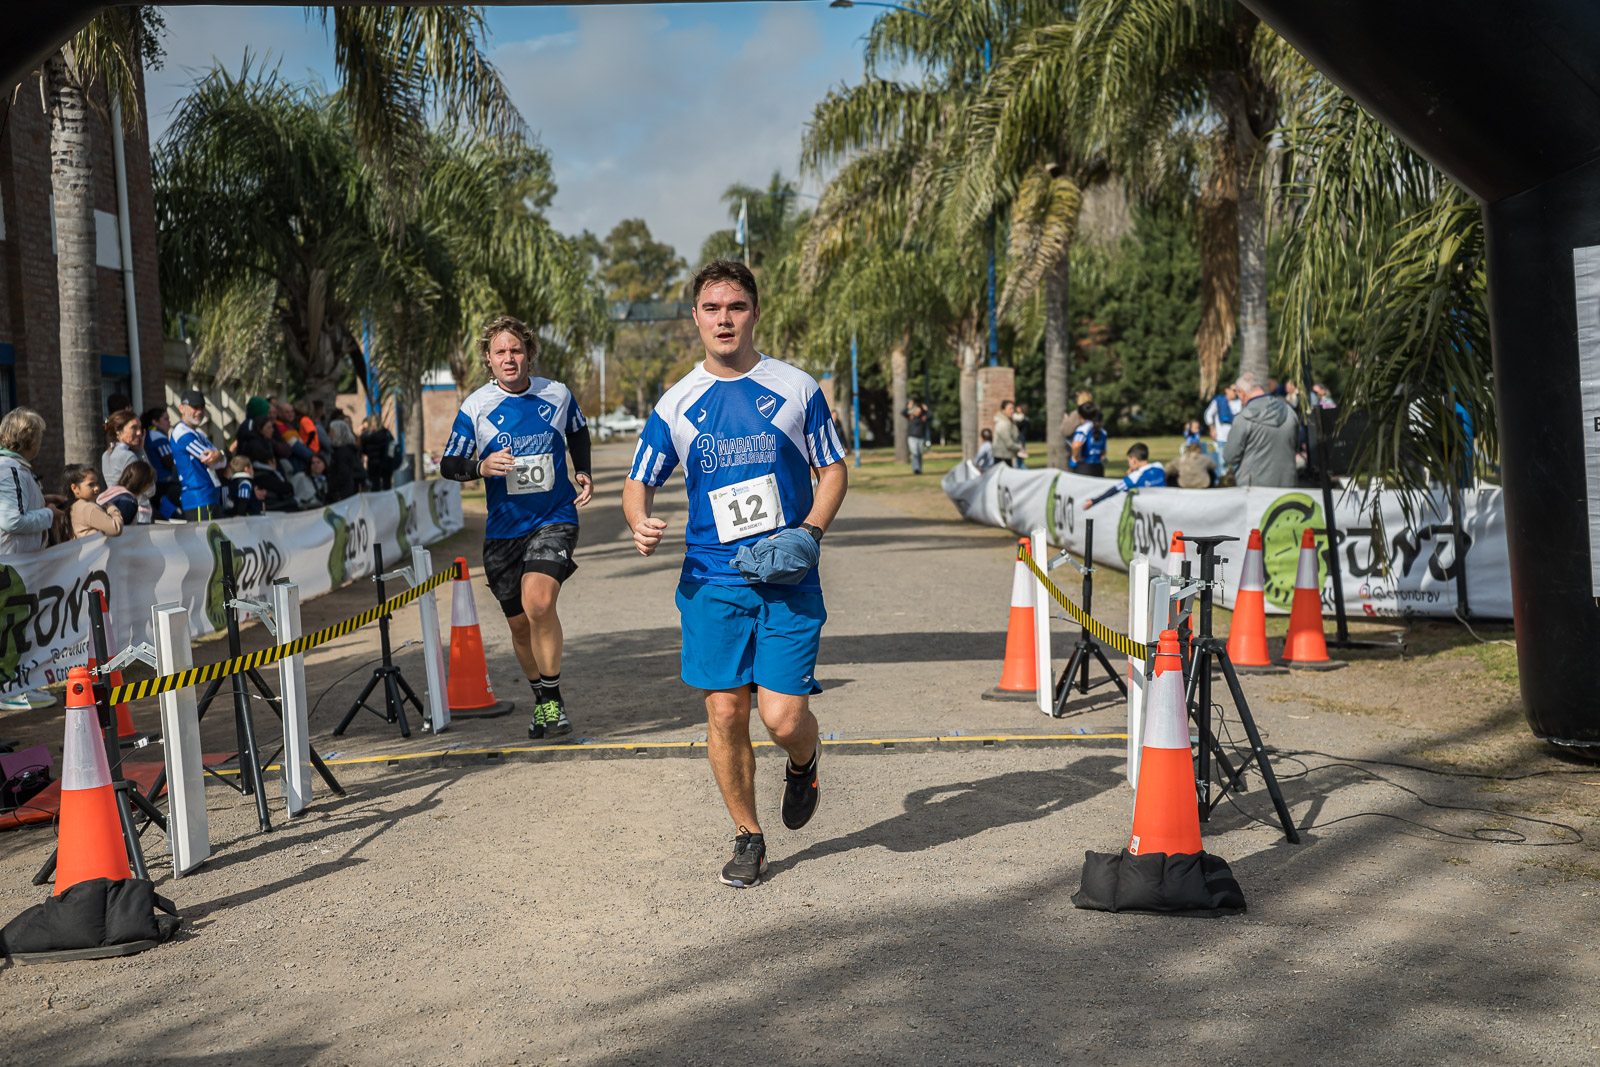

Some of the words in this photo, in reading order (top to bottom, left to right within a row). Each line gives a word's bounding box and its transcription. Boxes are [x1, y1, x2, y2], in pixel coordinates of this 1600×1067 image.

[697, 433, 717, 473] 3
[717, 432, 776, 456] MARATÓN
[516, 465, 545, 485] 30
[728, 494, 768, 526] 12
